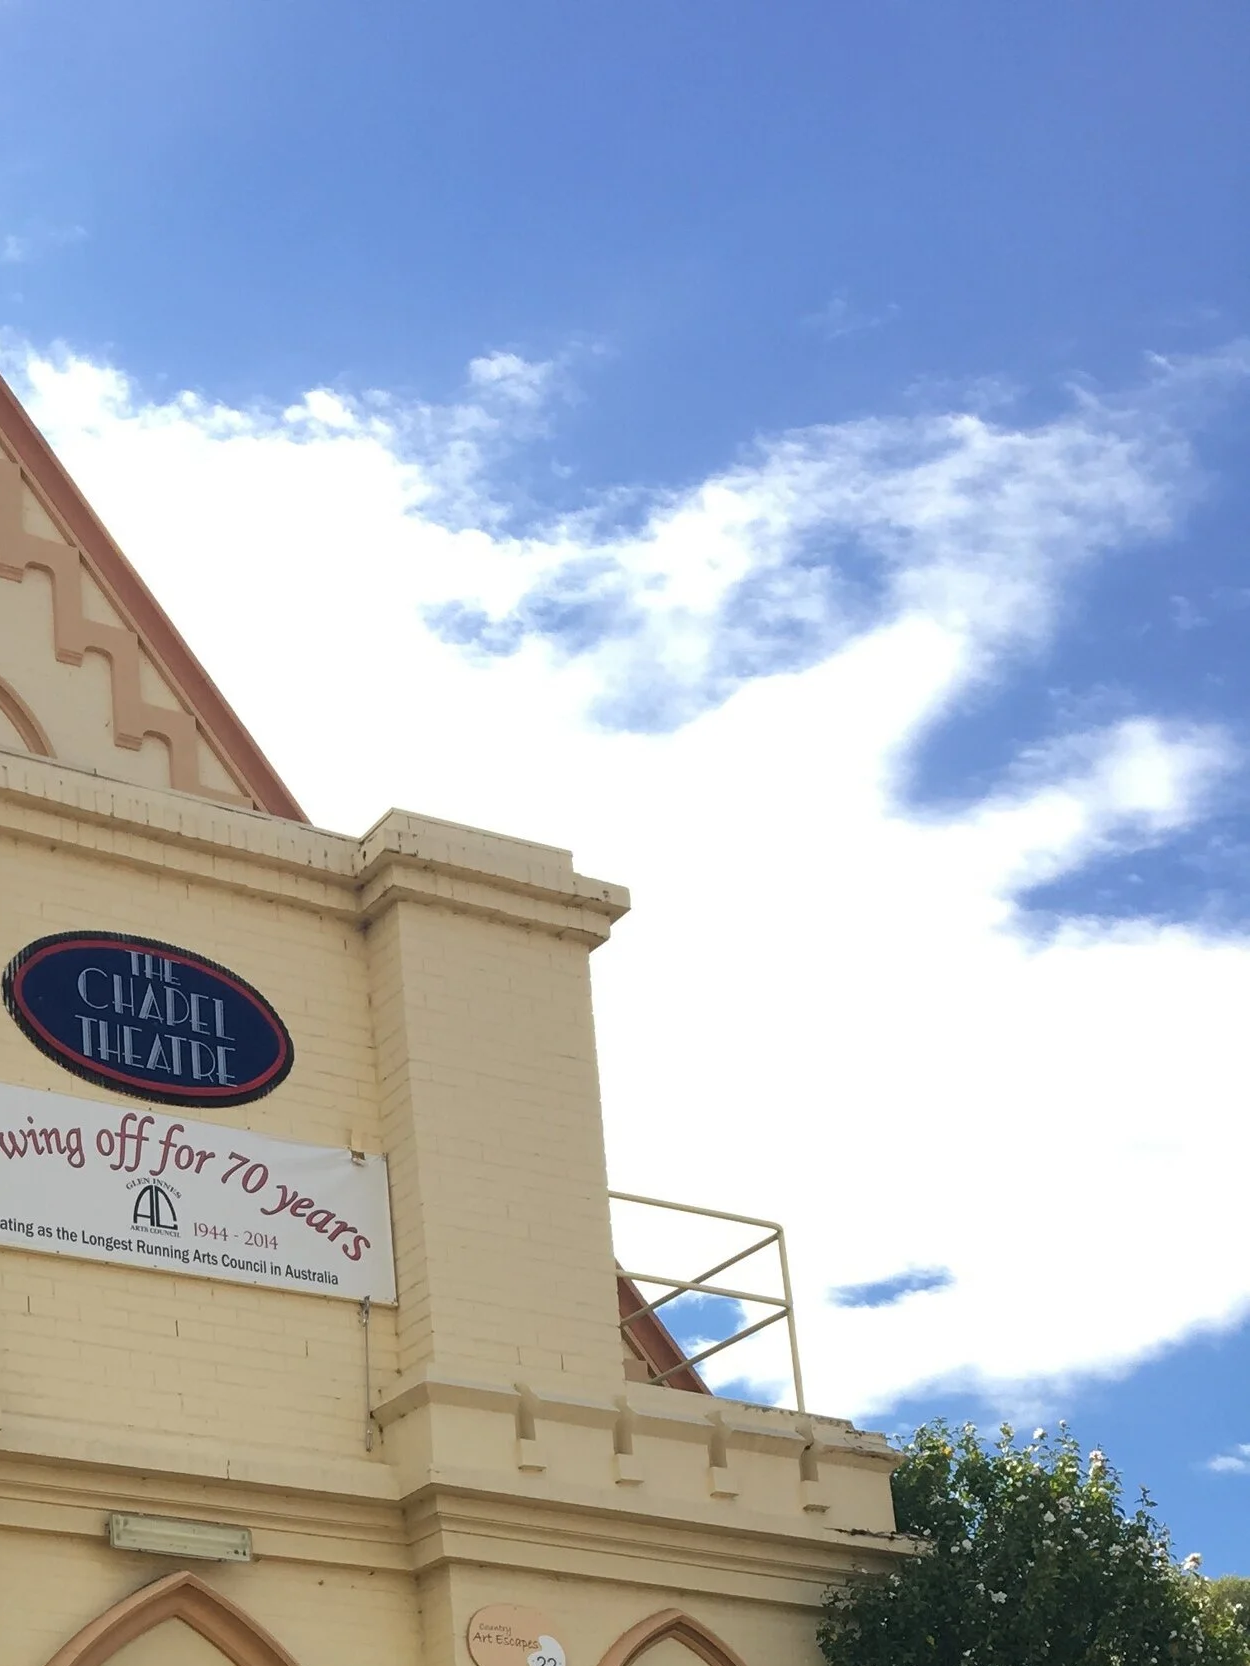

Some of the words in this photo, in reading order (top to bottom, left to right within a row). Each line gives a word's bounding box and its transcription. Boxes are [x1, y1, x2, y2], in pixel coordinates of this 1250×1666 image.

[125, 950, 181, 986] THE
[77, 967, 235, 1041] CHAPEL
[75, 1014, 238, 1088] THEATRE
[96, 1112, 155, 1173] off
[149, 1123, 216, 1177] for
[221, 1151, 269, 1194] 70
[260, 1184, 371, 1262] years
[126, 1177, 150, 1190] GLEN
[153, 1178, 182, 1199] INNES
[130, 1225, 149, 1233] ARTS
[150, 1228, 181, 1238] COUNCIL
[193, 1222, 228, 1242] 1944
[244, 1230, 278, 1250] 2014
[37, 1225, 53, 1238] as
[56, 1227, 78, 1242] the
[82, 1230, 132, 1251] Longest
[136, 1239, 190, 1263] Running
[193, 1249, 218, 1266] Arts
[221, 1254, 267, 1274] Council
[270, 1262, 281, 1276] in
[285, 1264, 338, 1286] Australia
[472, 1632, 492, 1644] Art
[495, 1634, 538, 1652] Escapes
[479, 1623, 512, 1637] Country
